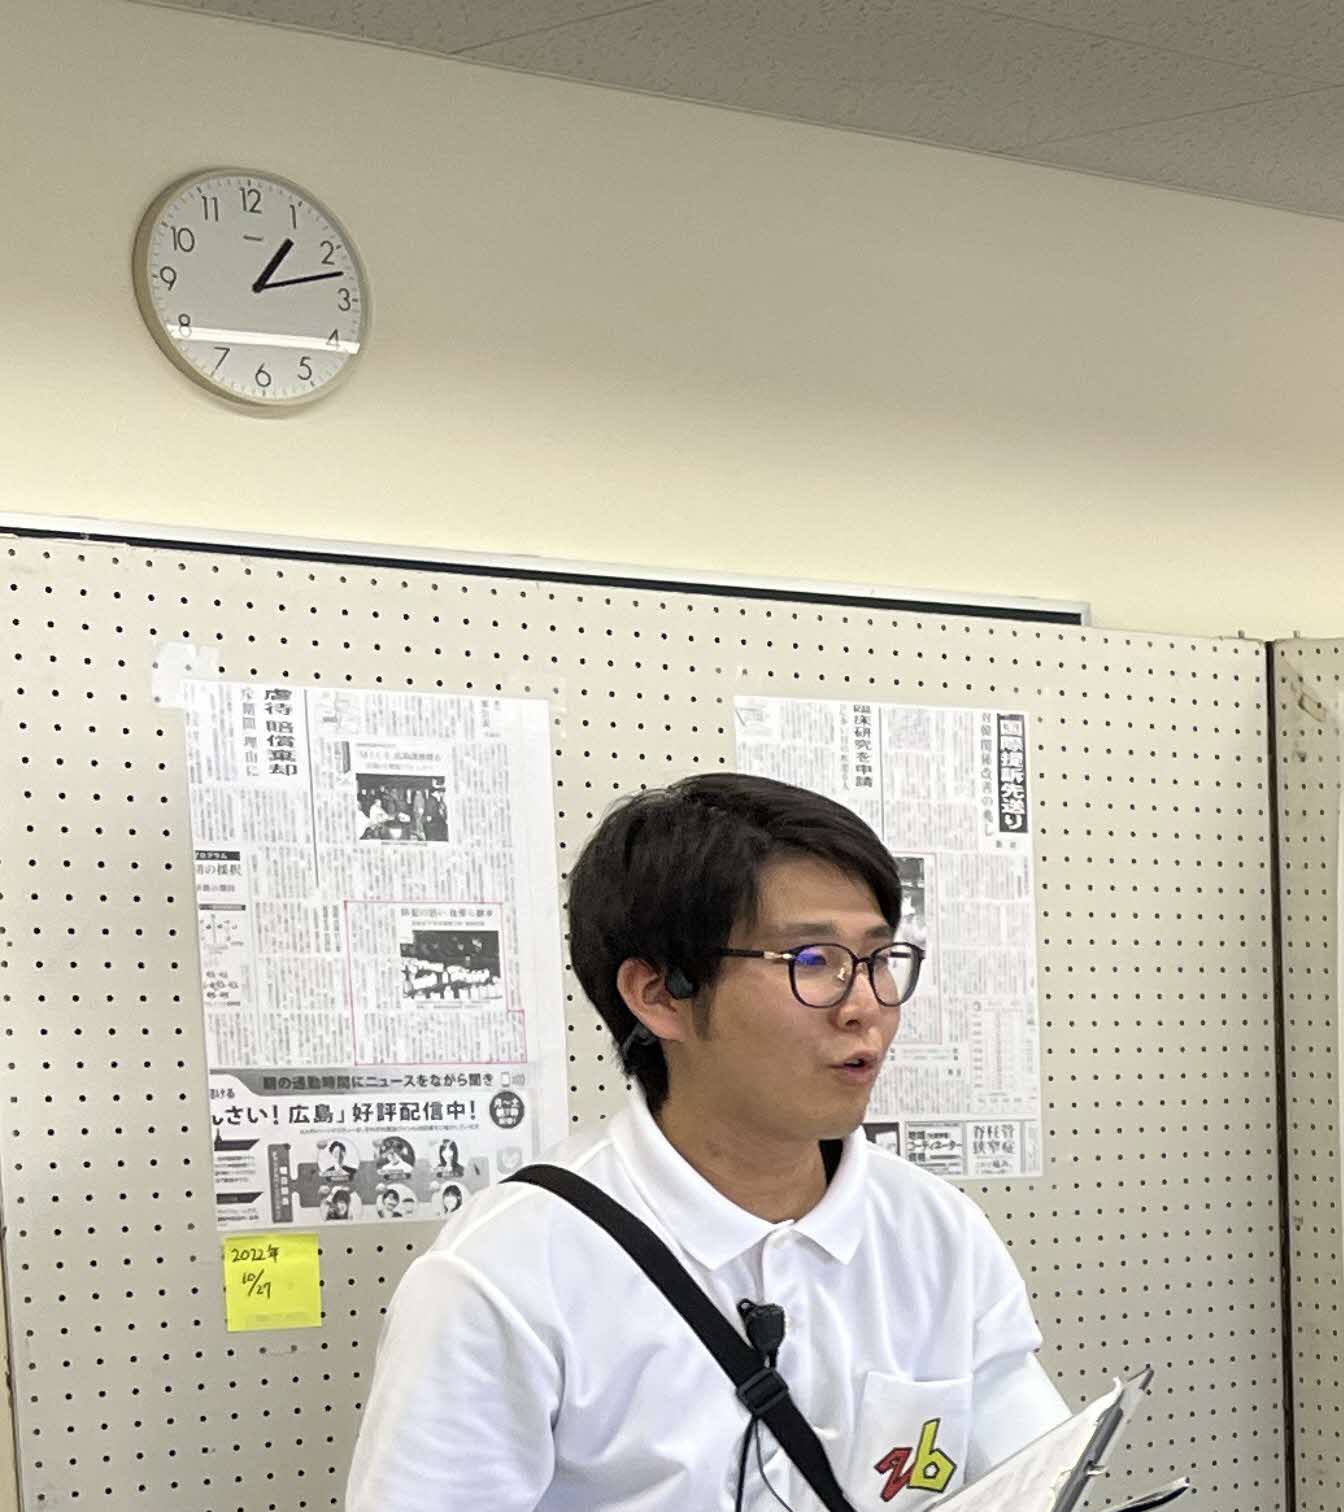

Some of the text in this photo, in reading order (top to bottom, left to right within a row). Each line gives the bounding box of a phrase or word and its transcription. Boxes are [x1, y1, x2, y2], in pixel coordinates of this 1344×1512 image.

[201, 195, 219, 222] 11
[240, 187, 262, 214] 12
[289, 203, 298, 230] 1
[171, 226, 195, 253] 10
[319, 239, 336, 265] 2
[160, 266, 177, 291] 9
[337, 288, 351, 312] 3
[212, 346, 231, 376] 7
[255, 361, 272, 388] 6
[297, 355, 313, 381] 5
[231, 1243, 280, 1263] 2022年
[242, 1267, 272, 1300] 10/27
